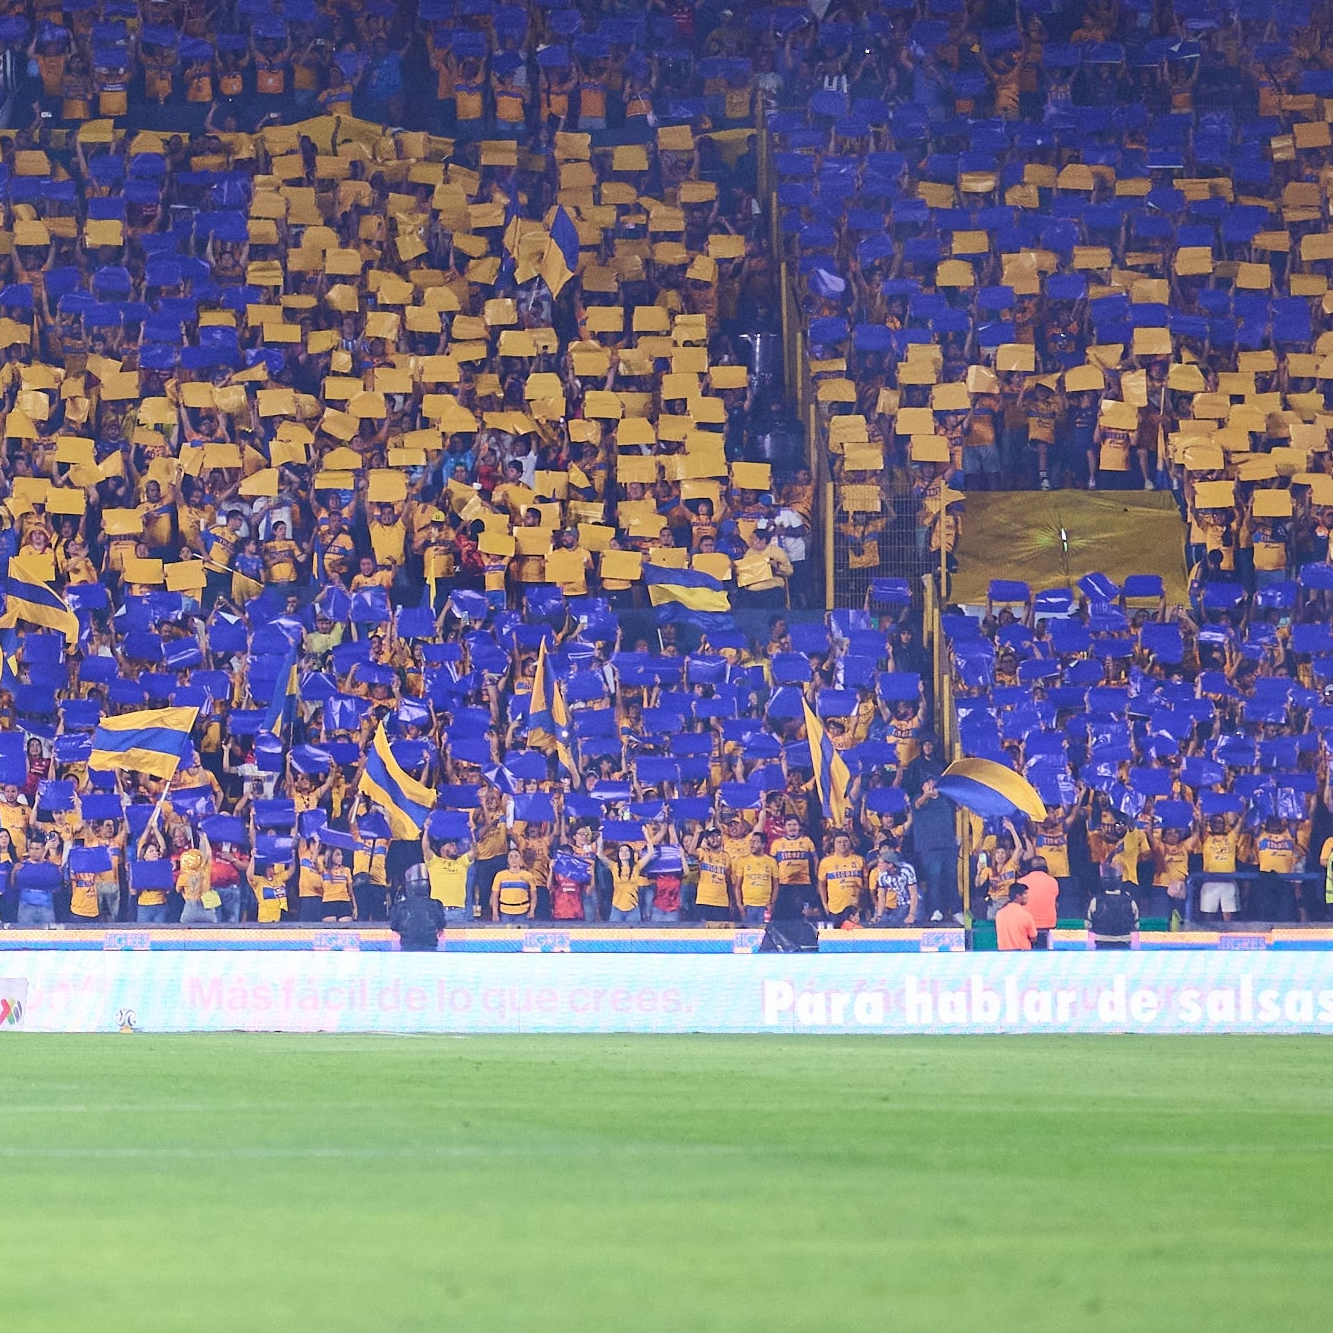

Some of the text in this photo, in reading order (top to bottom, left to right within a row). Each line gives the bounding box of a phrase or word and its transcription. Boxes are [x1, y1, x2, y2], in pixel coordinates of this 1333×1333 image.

[189, 977, 694, 1018] Más fácil de lo que crees.
[762, 980, 885, 1025] Para
[905, 975, 1075, 1024] hablar
[1099, 974, 1159, 1024] de
